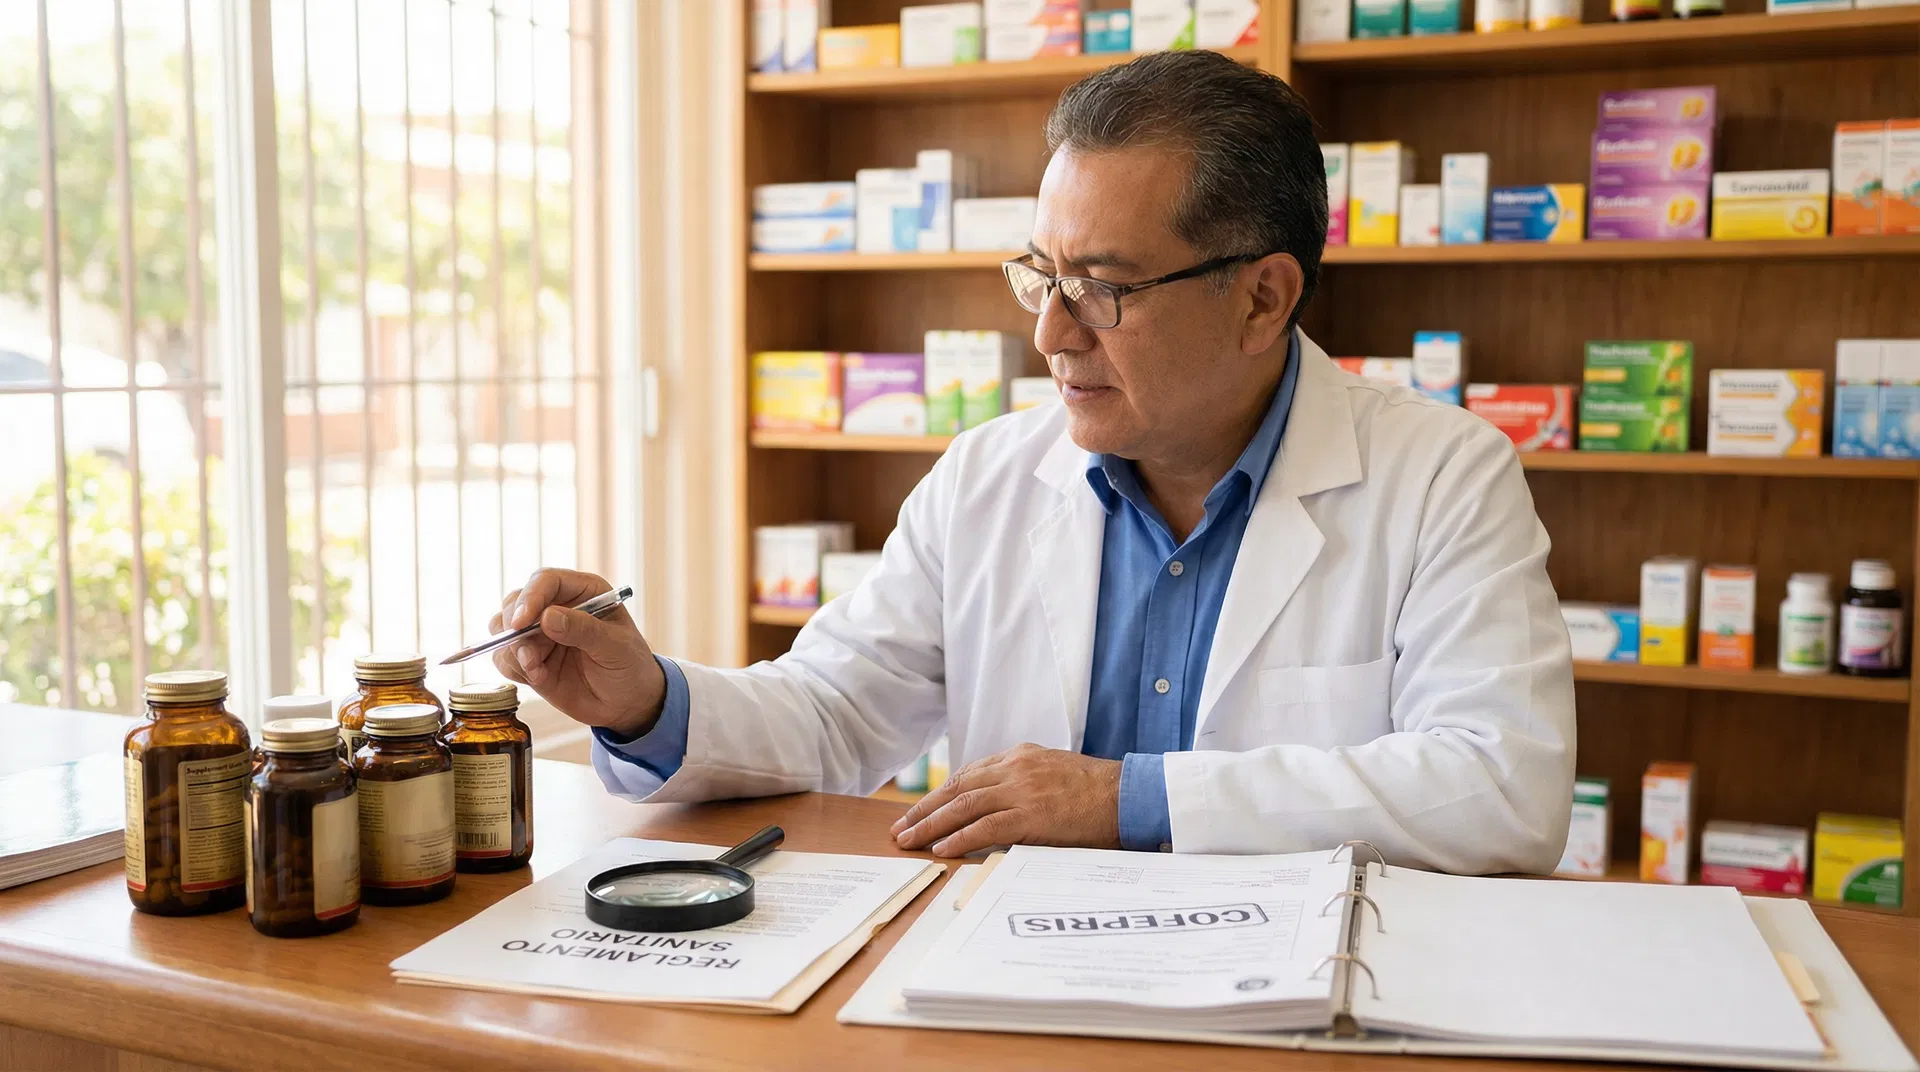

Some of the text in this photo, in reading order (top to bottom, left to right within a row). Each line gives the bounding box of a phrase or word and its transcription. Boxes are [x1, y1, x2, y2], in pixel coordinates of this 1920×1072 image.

[1024, 909, 1251, 931] COFEPRIS
[551, 928, 733, 951] SANITARIO
[502, 939, 740, 968] REGLAMENTO
